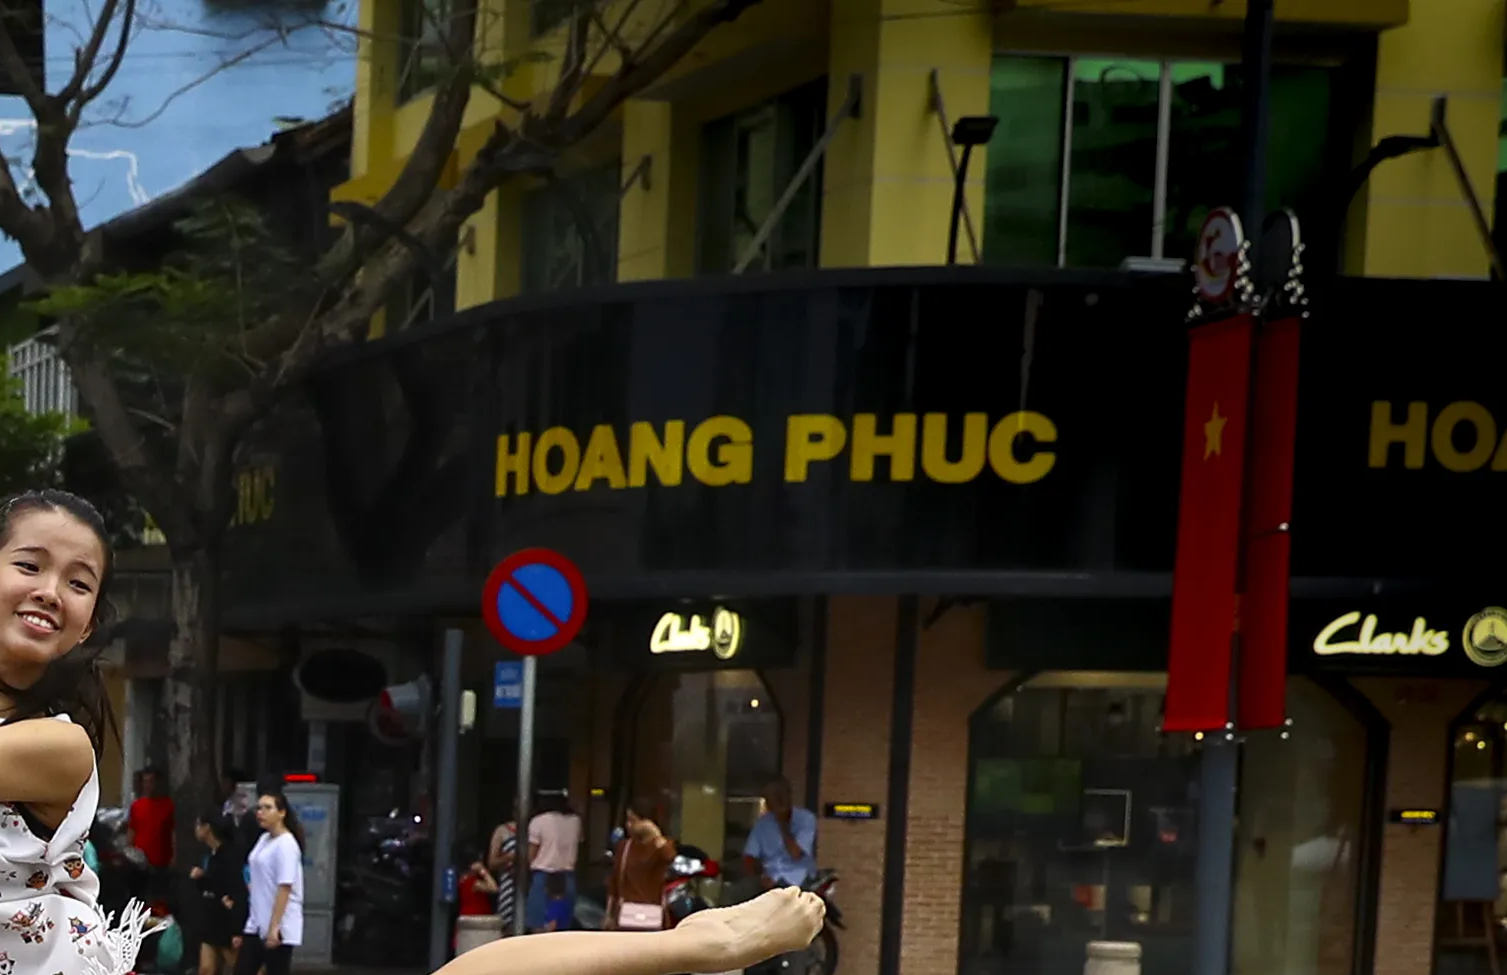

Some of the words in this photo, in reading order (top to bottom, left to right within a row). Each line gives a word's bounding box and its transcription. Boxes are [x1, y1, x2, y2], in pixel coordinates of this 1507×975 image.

[495, 415, 754, 498] HOANG
[784, 411, 1058, 484] PHUC
[1368, 400, 1507, 472] HO
[1313, 611, 1450, 655] Clarks
